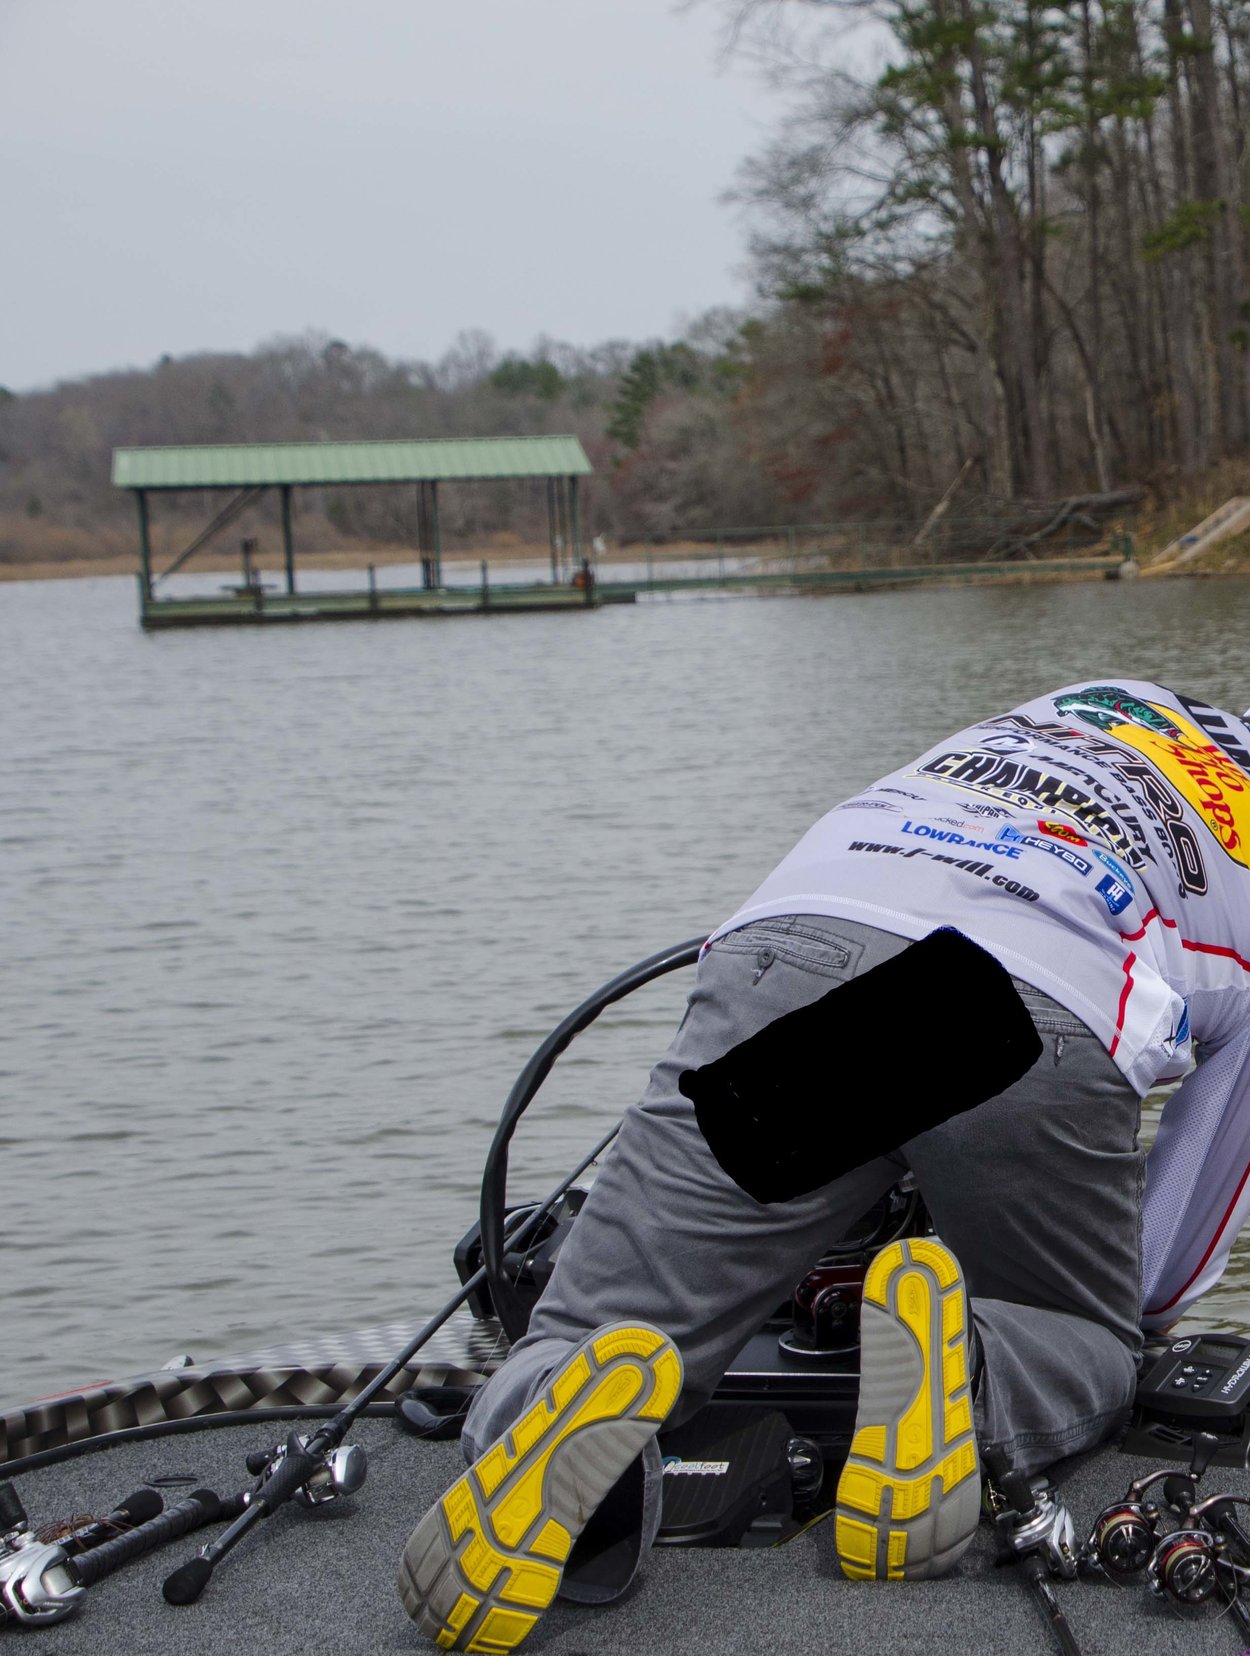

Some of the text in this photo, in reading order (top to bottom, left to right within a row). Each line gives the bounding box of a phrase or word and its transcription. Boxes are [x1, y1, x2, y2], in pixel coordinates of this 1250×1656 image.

[901, 821, 1025, 860] LOWRANCE
[915, 751, 1147, 871] CHAMPION
[984, 714, 1209, 896] NITRO
[1028, 754, 1159, 867] MERCURY
[1110, 771, 1158, 822] BASS
[1154, 826, 1189, 901] BOS
[1150, 740, 1242, 851] Shops
[1024, 836, 1089, 873] HEYBO
